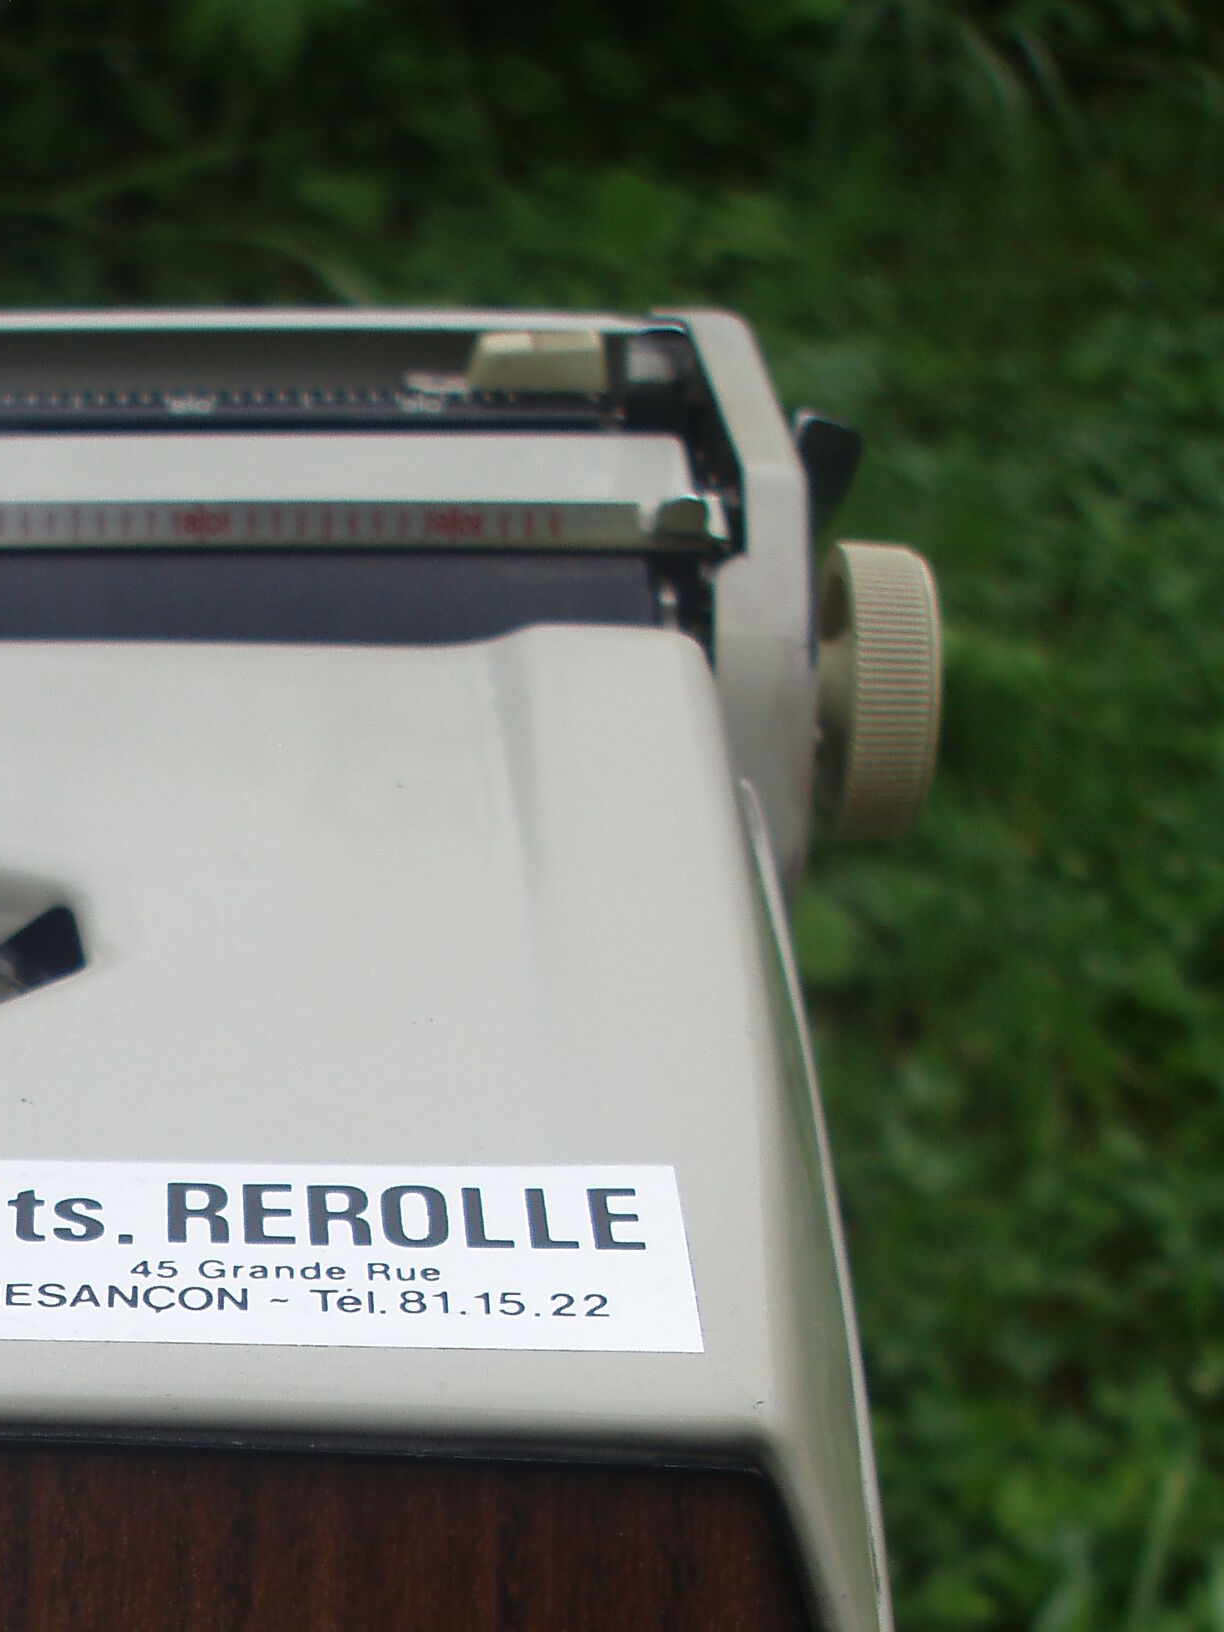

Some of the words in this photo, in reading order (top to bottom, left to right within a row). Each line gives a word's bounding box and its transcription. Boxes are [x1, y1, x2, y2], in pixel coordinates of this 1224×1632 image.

[166, 1182, 647, 1251] REROLLE
[130, 1260, 178, 1279] 45
[198, 1259, 346, 1282] Grande
[367, 1262, 441, 1282] Rue
